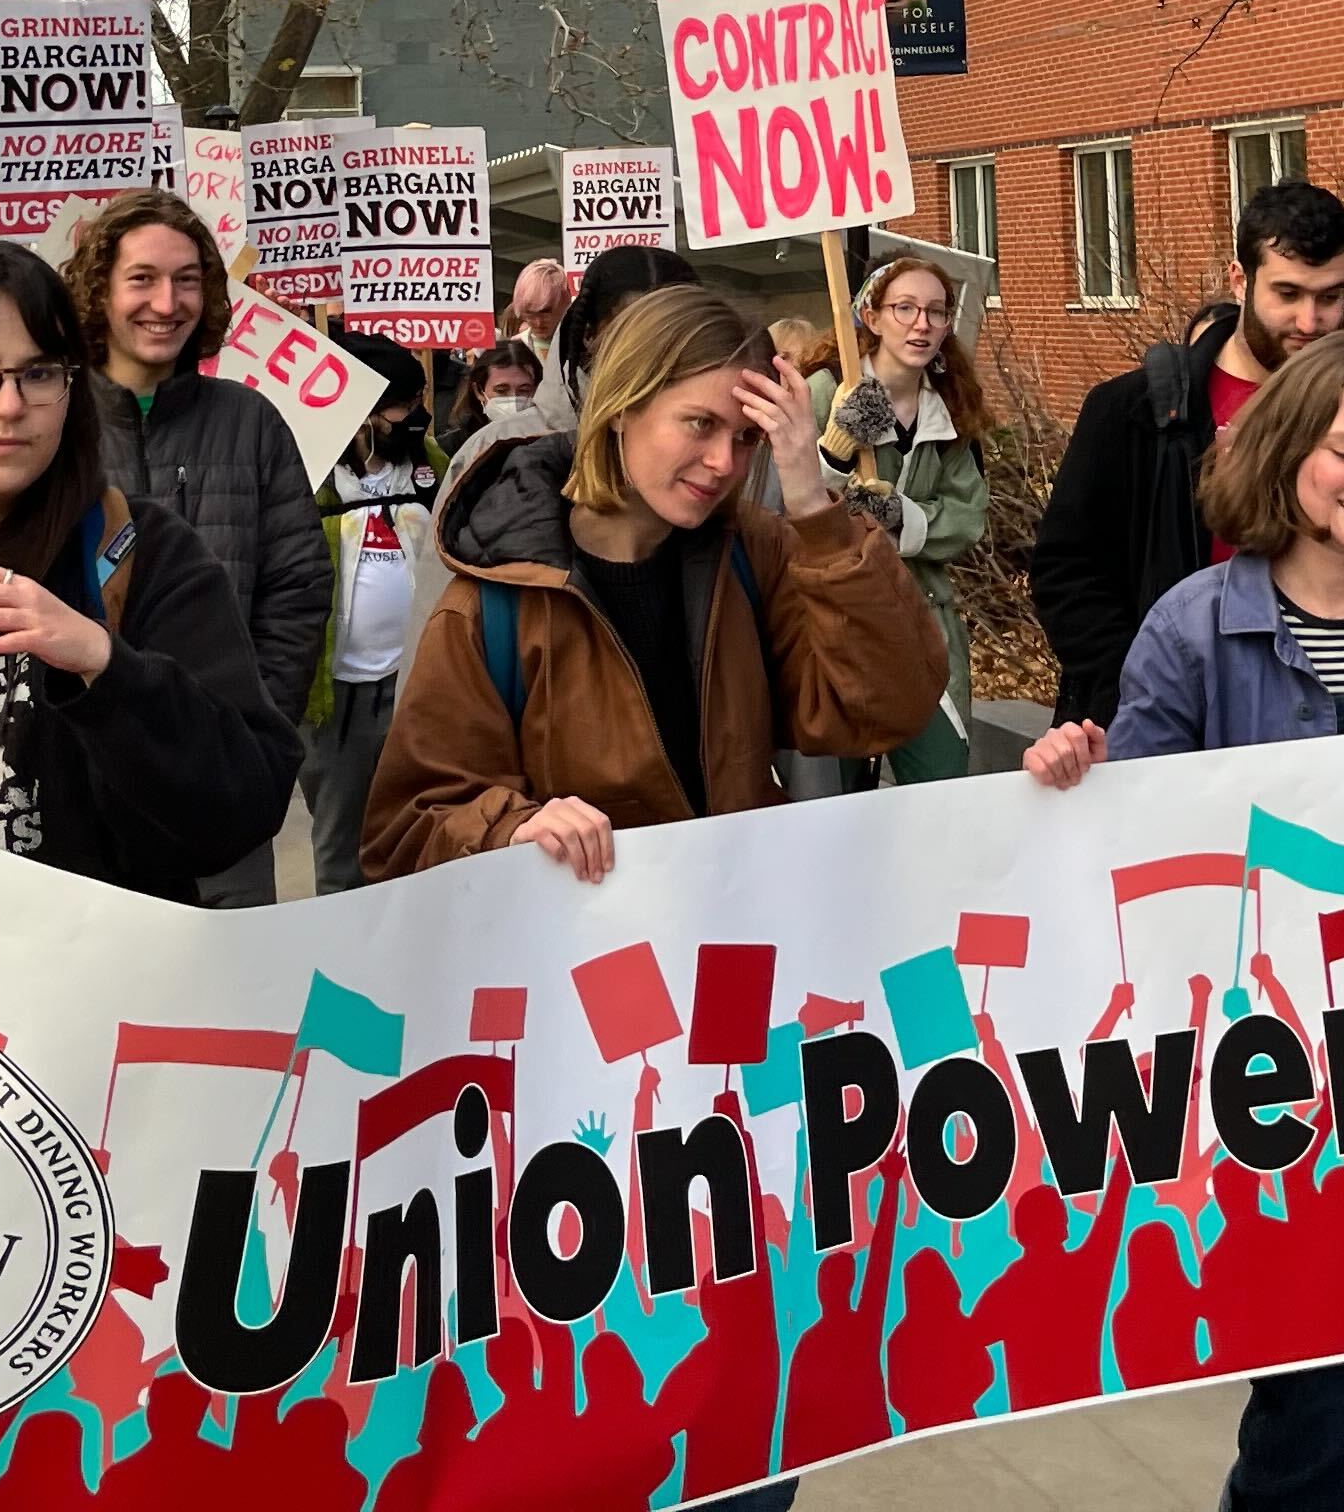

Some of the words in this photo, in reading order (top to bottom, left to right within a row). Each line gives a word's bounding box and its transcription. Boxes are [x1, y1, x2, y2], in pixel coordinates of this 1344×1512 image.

[902, 7, 933, 19] FOR
[0, 17, 145, 39] GRINNELL:
[0, 44, 145, 69] BARGAIN
[0, 71, 147, 113] NOW!
[2, 135, 46, 157] NO
[52, 131, 145, 155] MORE
[249, 134, 337, 156] GRINNE
[1, 156, 146, 182] THREATS!
[251, 155, 336, 180] BARGA
[343, 146, 475, 169] GRINNELL:
[573, 161, 661, 176] GRINNELL:
[691, 88, 893, 240] NOW!
[343, 172, 476, 197] BARGAIN
[573, 178, 661, 195] BARGAIN
[346, 198, 479, 238] NOW!
[573, 194, 662, 222] NOW!
[257, 226, 291, 245] NO
[297, 223, 341, 241] MO
[574, 235, 601, 249] NO
[605, 233, 661, 248] MORE
[350, 257, 394, 279] NO
[399, 257, 480, 279] MORE
[350, 280, 481, 303] THREATS!
[16, 1109, 95, 1221] DINING
[173, 1083, 757, 1395] Union
[8, 1230, 96, 1378] WORKERS
